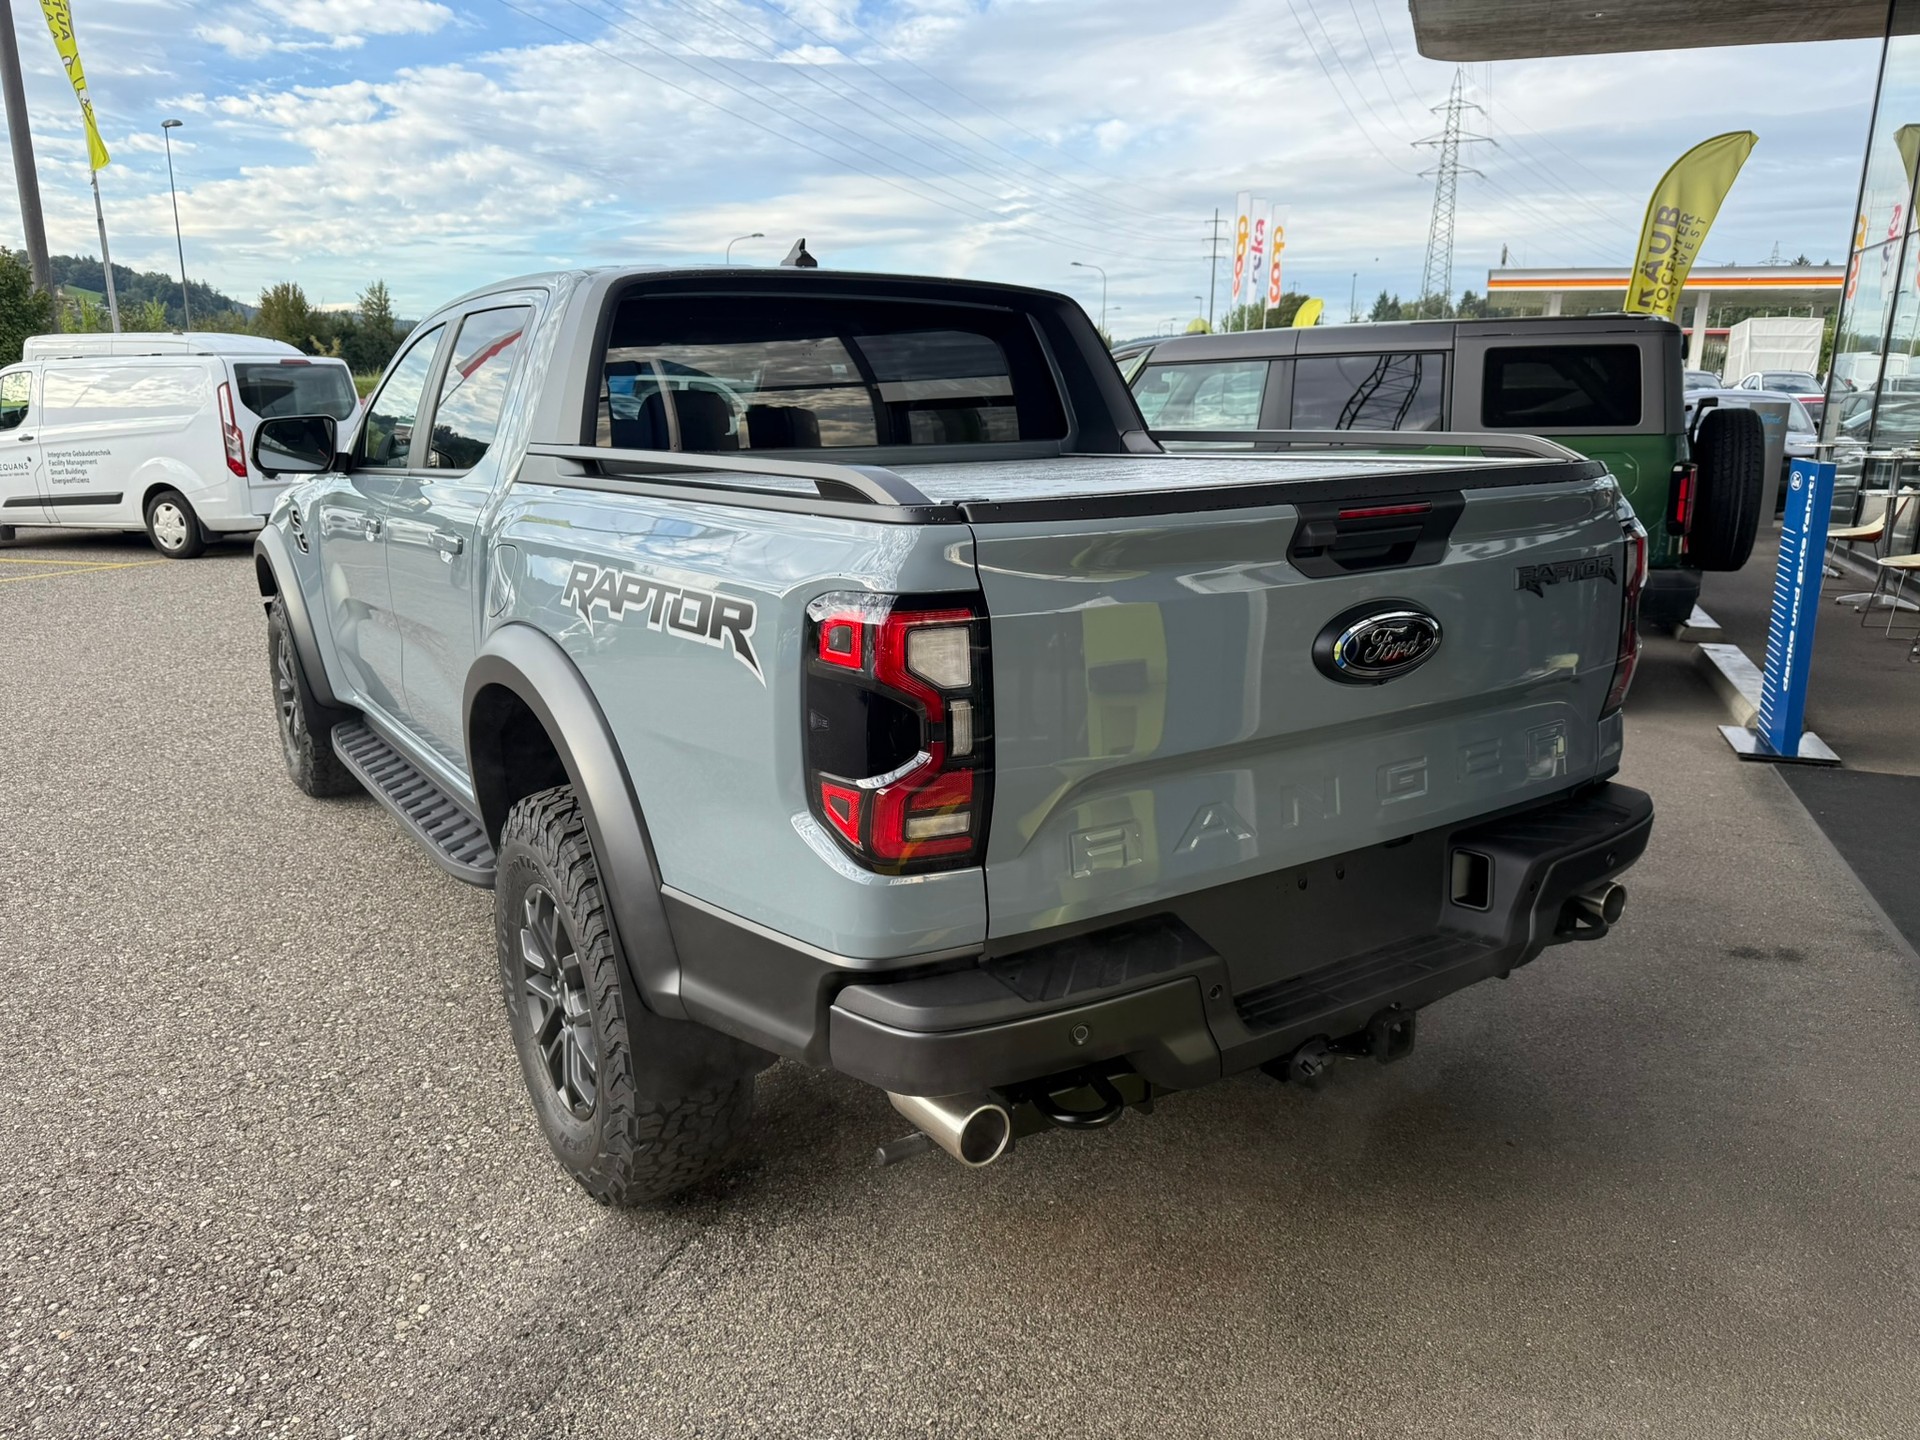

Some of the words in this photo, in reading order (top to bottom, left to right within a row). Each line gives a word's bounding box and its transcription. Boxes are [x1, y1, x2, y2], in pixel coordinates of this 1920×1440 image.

[1269, 225, 1285, 303] coop
[1637, 205, 1680, 308] KÄUB
[1676, 217, 1706, 266] WEST
[1513, 555, 1618, 598] RAPTOR
[560, 560, 767, 688] RAPTOR
[1364, 626, 1430, 663] Ford
[1782, 629, 1796, 692] danke
[1790, 586, 1801, 627] und
[1067, 719, 1568, 880] RANGER
